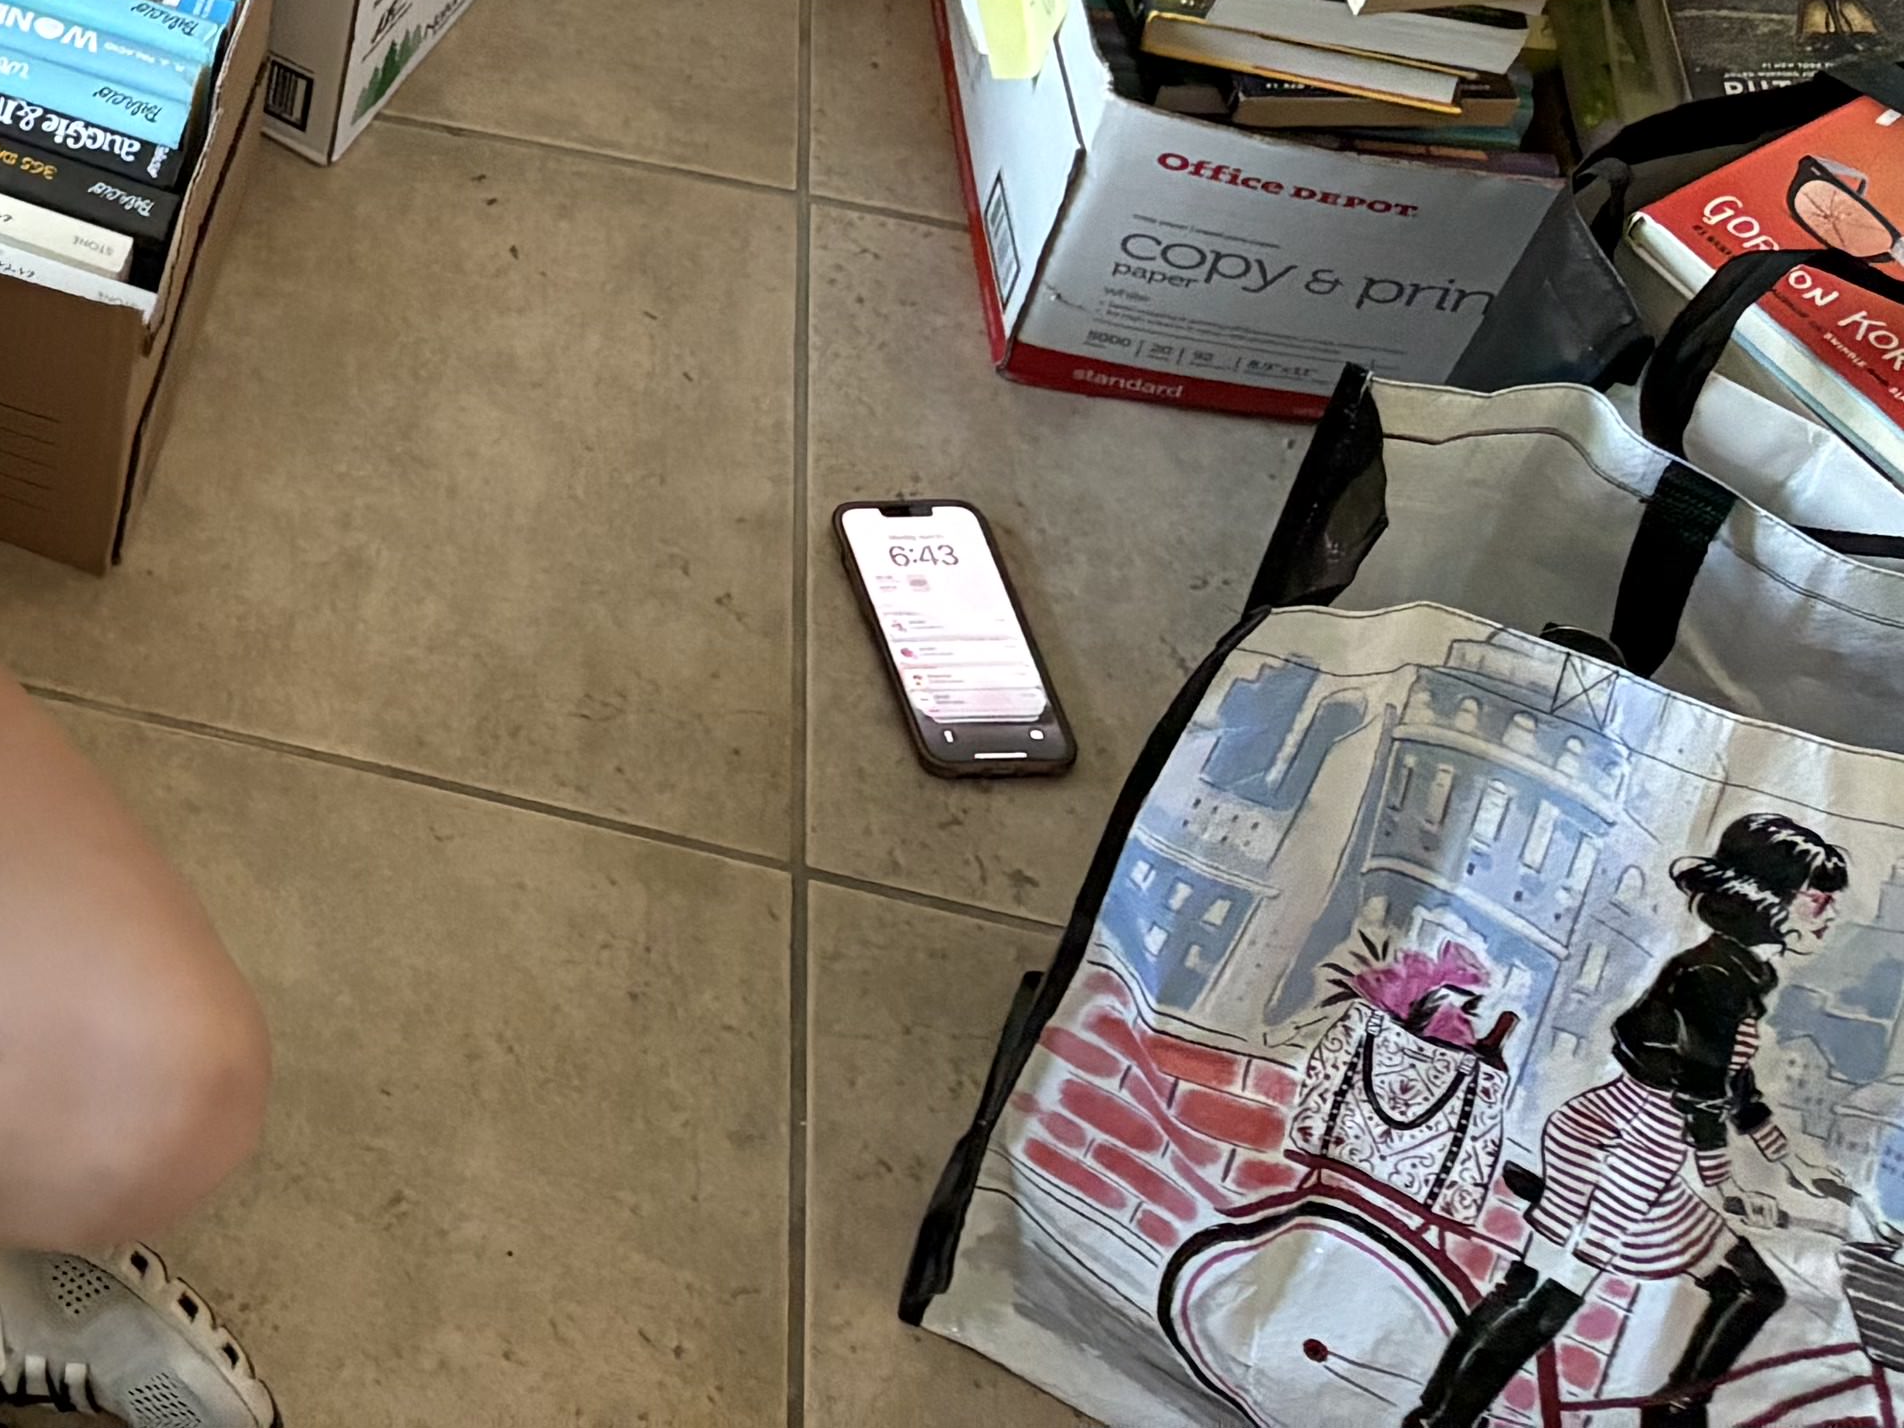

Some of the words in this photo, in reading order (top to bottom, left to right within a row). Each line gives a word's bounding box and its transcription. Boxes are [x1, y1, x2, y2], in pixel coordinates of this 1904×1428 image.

[21, 156, 58, 180] 365
[1156, 151, 1284, 196] Office
[1288, 184, 1419, 219] DEPOT
[1111, 261, 1199, 289] paper
[1119, 232, 1299, 294] copy
[1303, 268, 1345, 294] &
[1072, 365, 1186, 400] standard
[888, 544, 959, 568] 6:43
